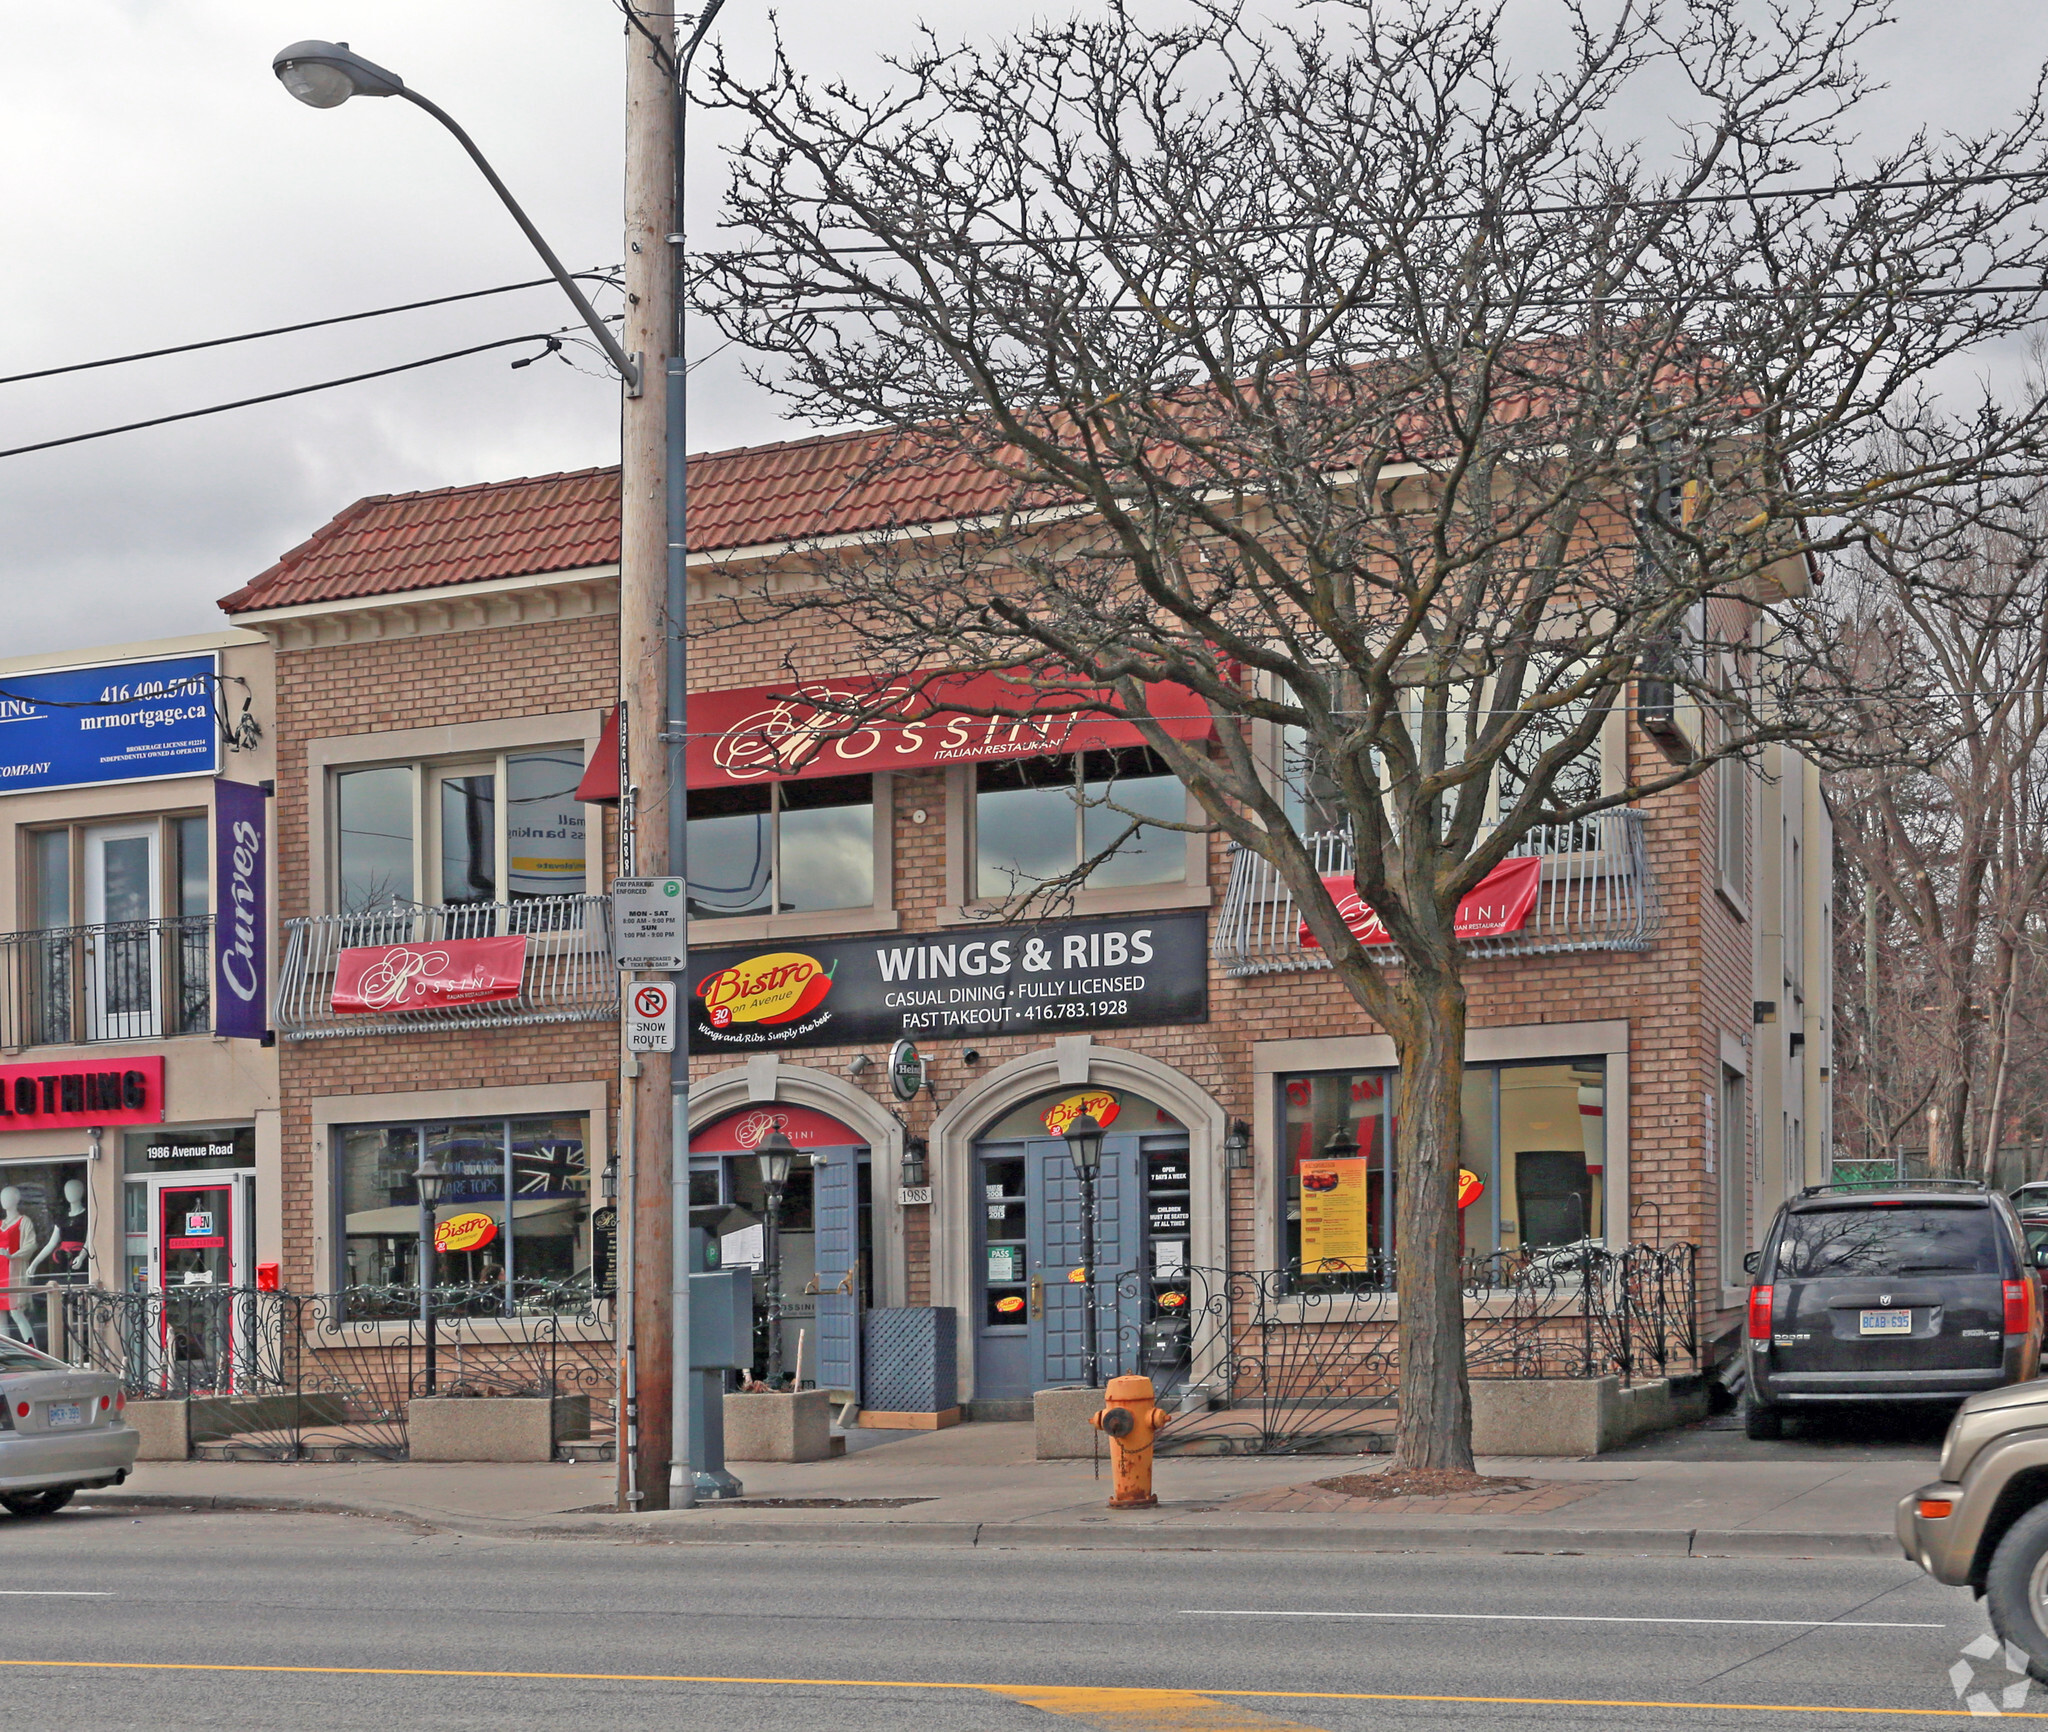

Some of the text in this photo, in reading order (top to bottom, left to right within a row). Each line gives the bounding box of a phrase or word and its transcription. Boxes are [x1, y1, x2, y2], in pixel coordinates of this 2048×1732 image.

[80, 705, 206, 729] mrmortgage.ca
[162, 740, 187, 749] LICENSE
[933, 744, 983, 760] ITALIAN
[222, 820, 259, 1001] Curves
[876, 929, 1154, 982] WINGS & RIBS
[357, 947, 495, 1009] ROSSINI
[696, 962, 813, 1007] Bistro
[732, 990, 793, 1014] on Avenue
[885, 975, 1146, 1007] CASUAL DINING FULLY LICENSED
[713, 1008, 728, 1020] 30
[903, 999, 1128, 1029] FAST TAKEOUT 416.783.1928
[636, 1022, 666, 1032] SNOW
[698, 1022, 723, 1041] Wings
[723, 1032, 744, 1043] and
[799, 1024, 815, 1034] the
[633, 1035, 667, 1045] ROUTE
[735, 1111, 813, 1148] RSINI
[147, 1143, 233, 1159] 1986 Avenue Road
[903, 1189, 928, 1202] 1988
[434, 1218, 487, 1241] Bistro
[992, 1250, 1010, 1258] PASS
[1863, 1316, 1886, 1328] BCAB
